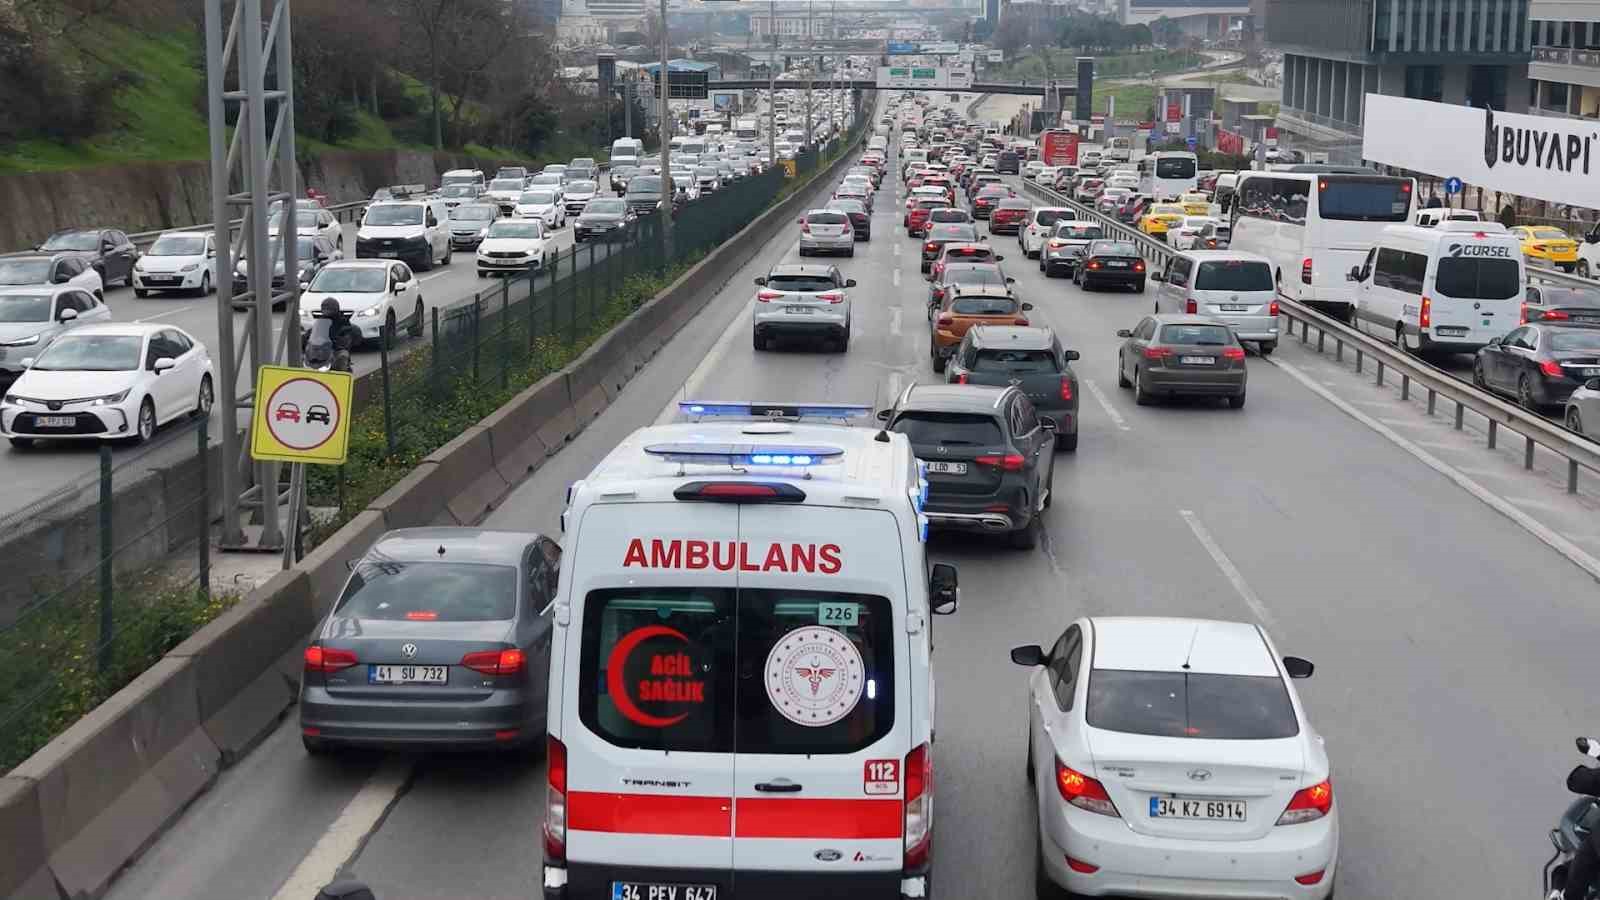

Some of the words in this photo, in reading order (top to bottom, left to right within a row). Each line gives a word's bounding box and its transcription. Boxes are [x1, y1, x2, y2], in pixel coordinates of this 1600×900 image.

[623, 538, 842, 574] AMBULANS
[825, 607, 852, 620] 226
[379, 667, 391, 679] 41
[402, 667, 415, 679] SU
[423, 667, 443, 679] 732
[869, 762, 895, 780] 112
[1159, 800, 1176, 815] 34
[1183, 801, 1200, 816] KZ
[1207, 802, 1242, 818] 6914
[623, 884, 640, 900] 34
[686, 887, 714, 900] 647
